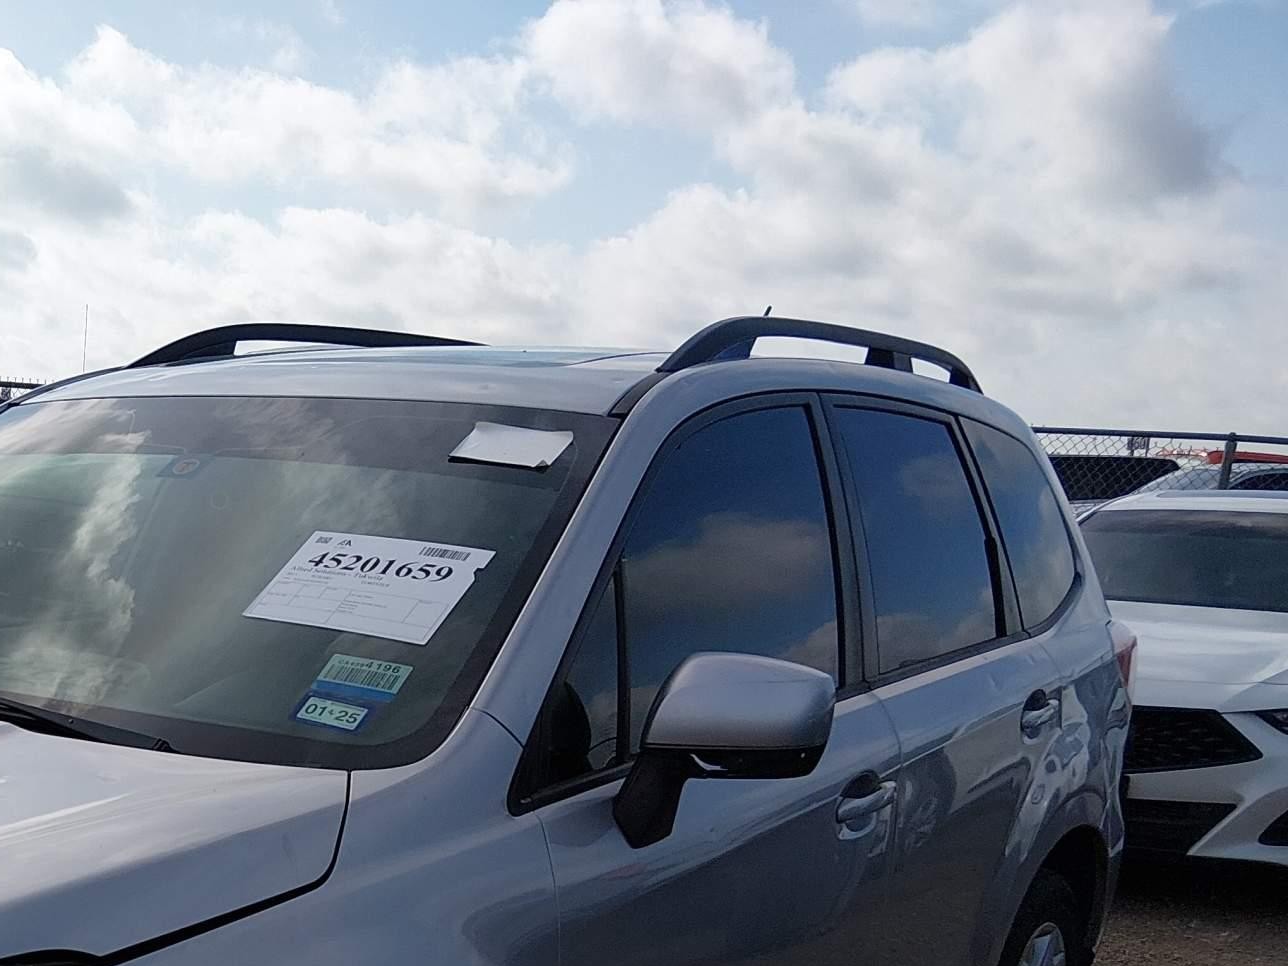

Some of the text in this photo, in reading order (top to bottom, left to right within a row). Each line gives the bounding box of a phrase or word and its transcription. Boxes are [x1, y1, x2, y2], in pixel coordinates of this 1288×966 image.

[308, 551, 454, 582] 45201659
[304, 703, 361, 724] 01 25
